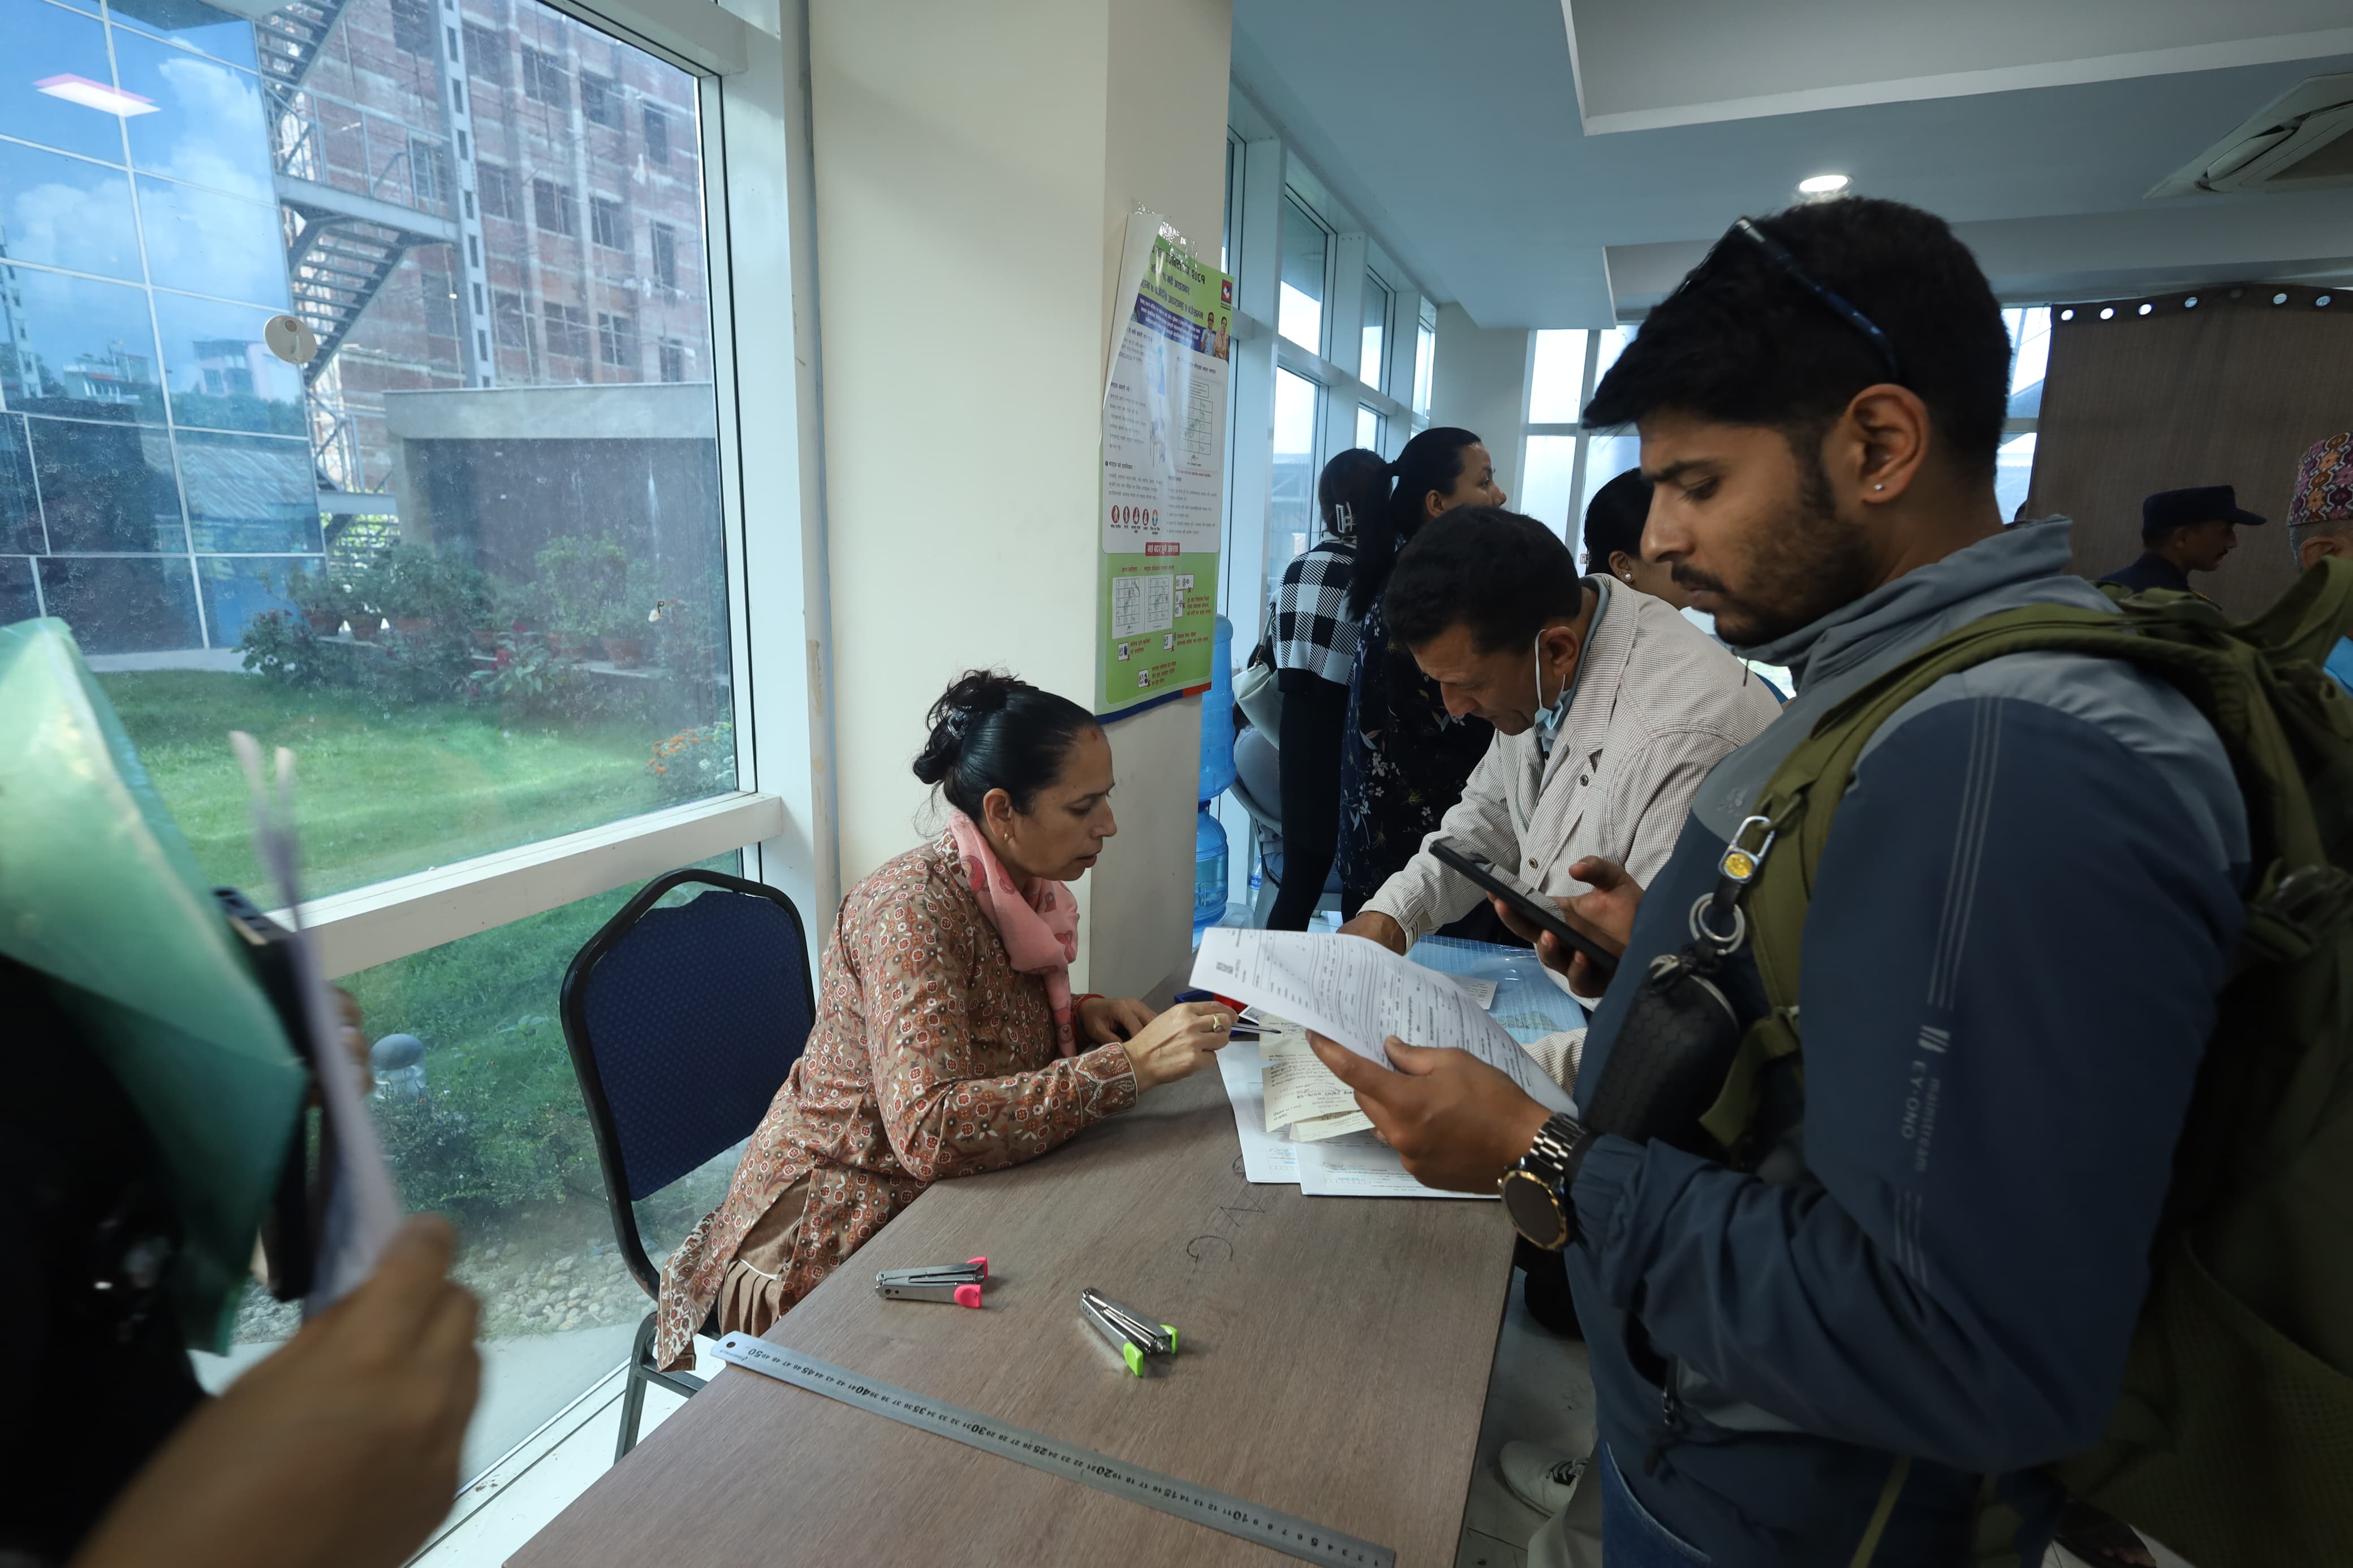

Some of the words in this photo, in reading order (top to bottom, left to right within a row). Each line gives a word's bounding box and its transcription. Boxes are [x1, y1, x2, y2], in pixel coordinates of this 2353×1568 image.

[748, 1349, 763, 1358] 50
[856, 1386, 870, 1396] 40
[912, 1406, 926, 1414] 35
[971, 1424, 987, 1435] 30
[1033, 1446, 1048, 1455] 25
[1096, 1467, 1113, 1478] 20
[1163, 1488, 1177, 1498] 15
[1233, 1511, 1248, 1522] 10
[1311, 1538, 1318, 1547] 5
